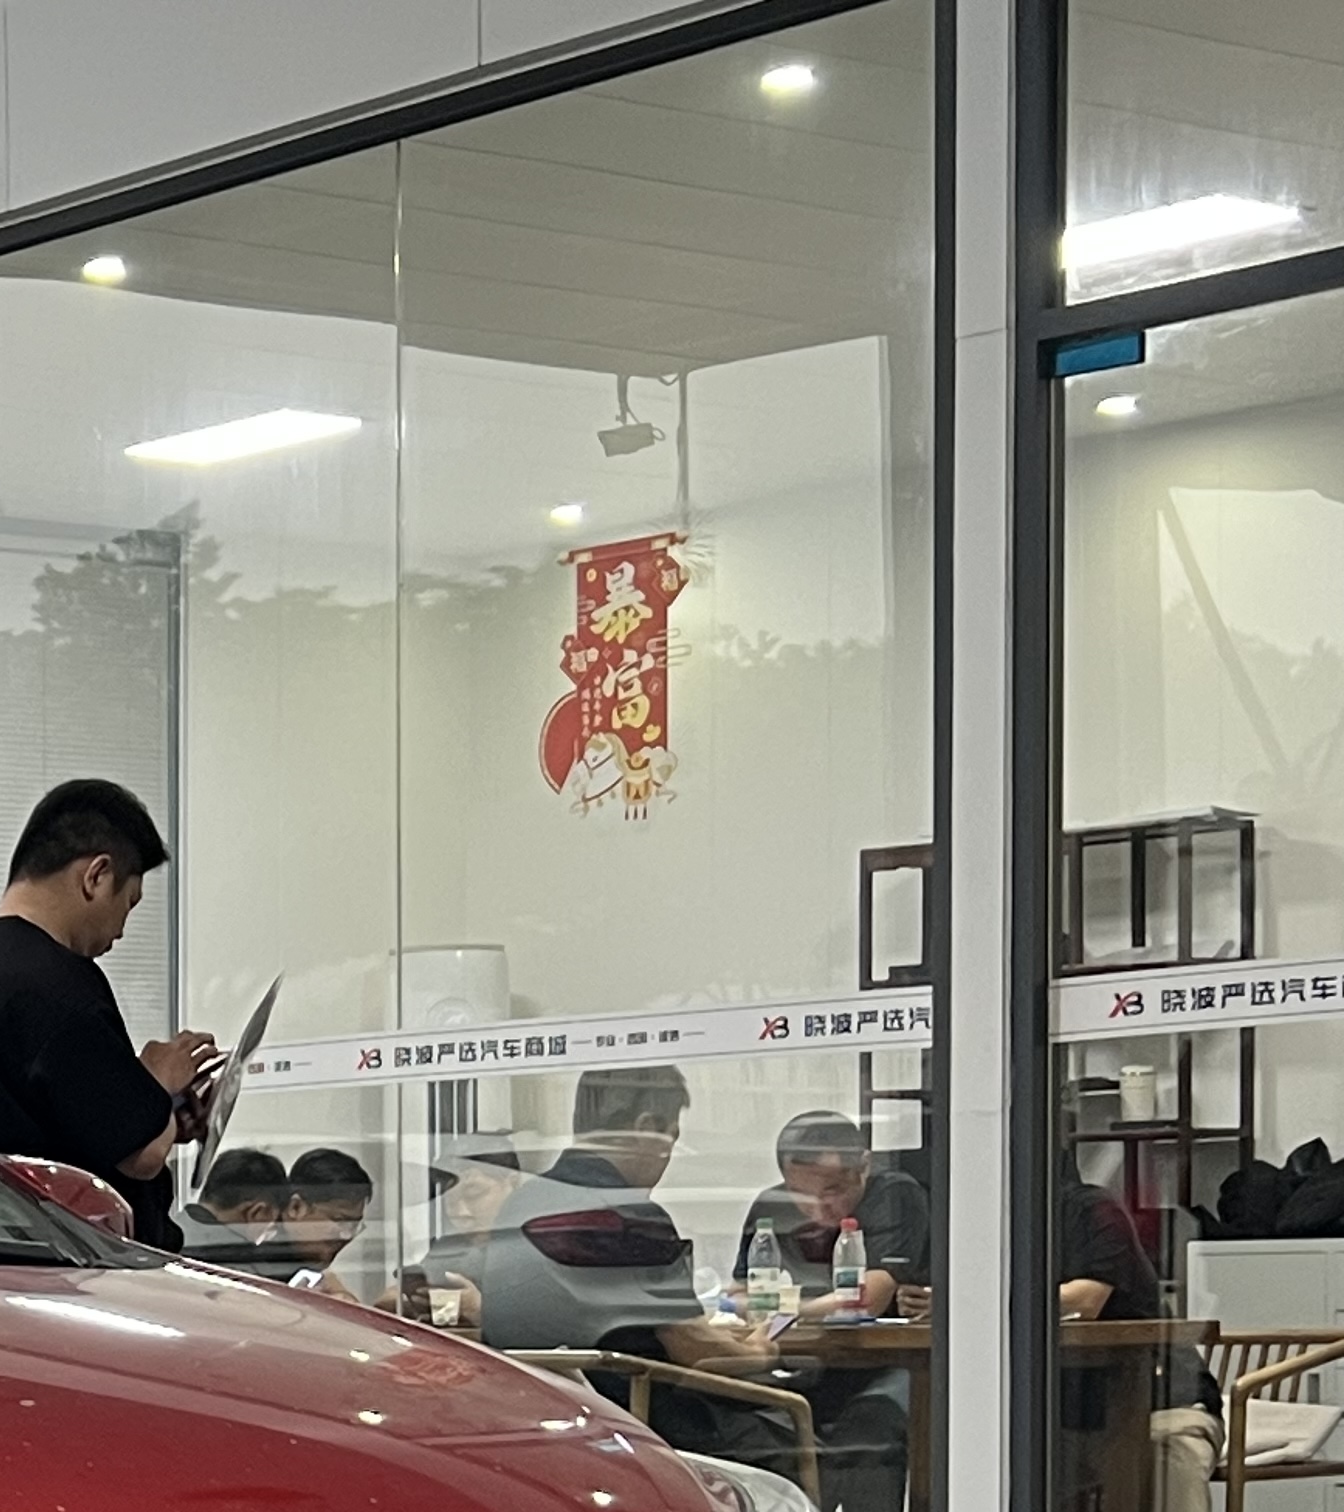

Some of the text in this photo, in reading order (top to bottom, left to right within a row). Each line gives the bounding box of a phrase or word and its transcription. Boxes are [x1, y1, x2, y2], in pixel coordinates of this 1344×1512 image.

[590, 561, 655, 729] 暴富
[1161, 976, 1344, 1013] 晓波严选汽车
[393, 1034, 568, 1068] 晓波严选汽车商城
